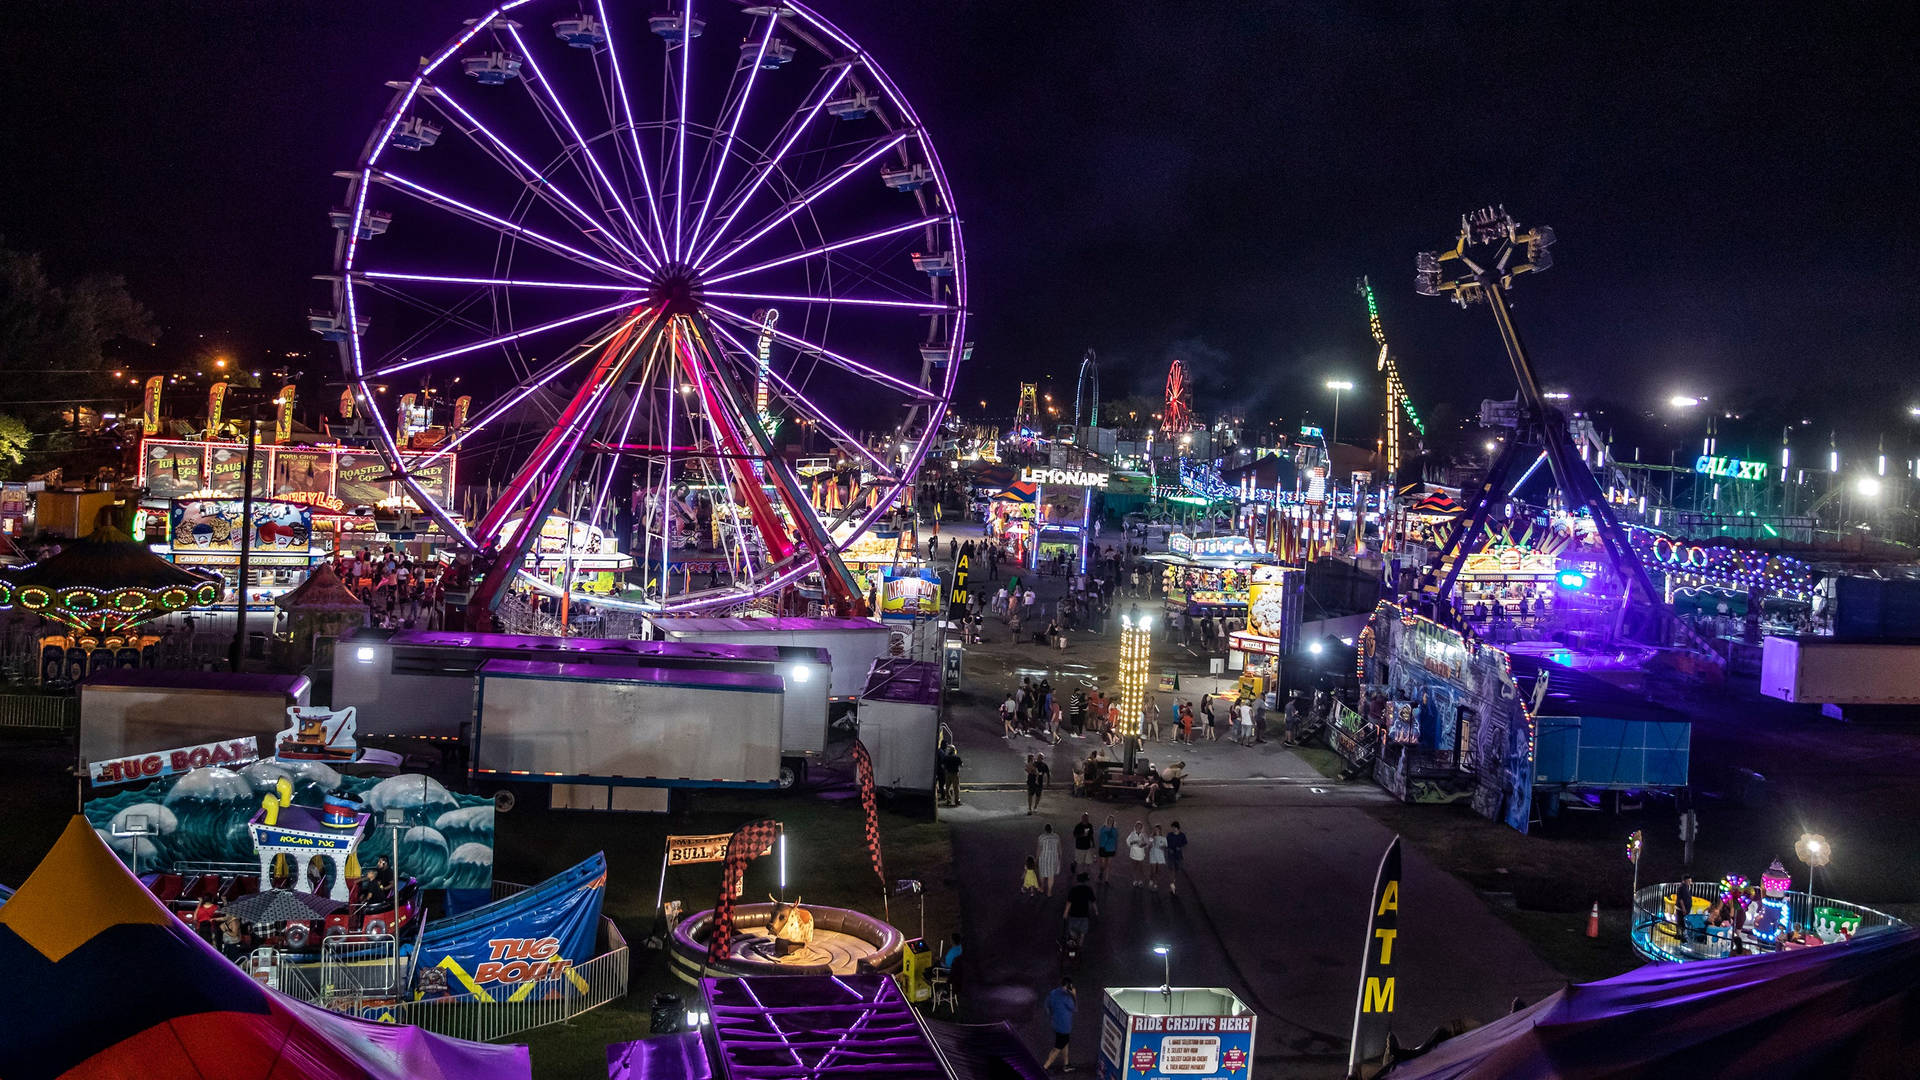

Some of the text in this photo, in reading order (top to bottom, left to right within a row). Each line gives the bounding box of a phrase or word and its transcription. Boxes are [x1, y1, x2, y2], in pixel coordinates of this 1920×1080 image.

[177, 467, 198, 479] EGS
[215, 460, 264, 474] SAUSGE
[339, 465, 385, 480] ROASTED
[1696, 456, 1767, 480] GALAXY
[1021, 468, 1109, 487] LEMONADE
[223, 502, 258, 515] SWET
[260, 505, 288, 519] SPOT
[1195, 540, 1233, 554] RISING
[952, 554, 969, 604] ATM
[948, 650, 959, 678] ATM
[108, 742, 245, 781] TUG BOAT
[672, 846, 709, 861] BULL
[489, 938, 560, 960] TUG
[1363, 880, 1398, 1013] ATM
[1135, 1017, 1250, 1031] RIDE CREDITS HERE
